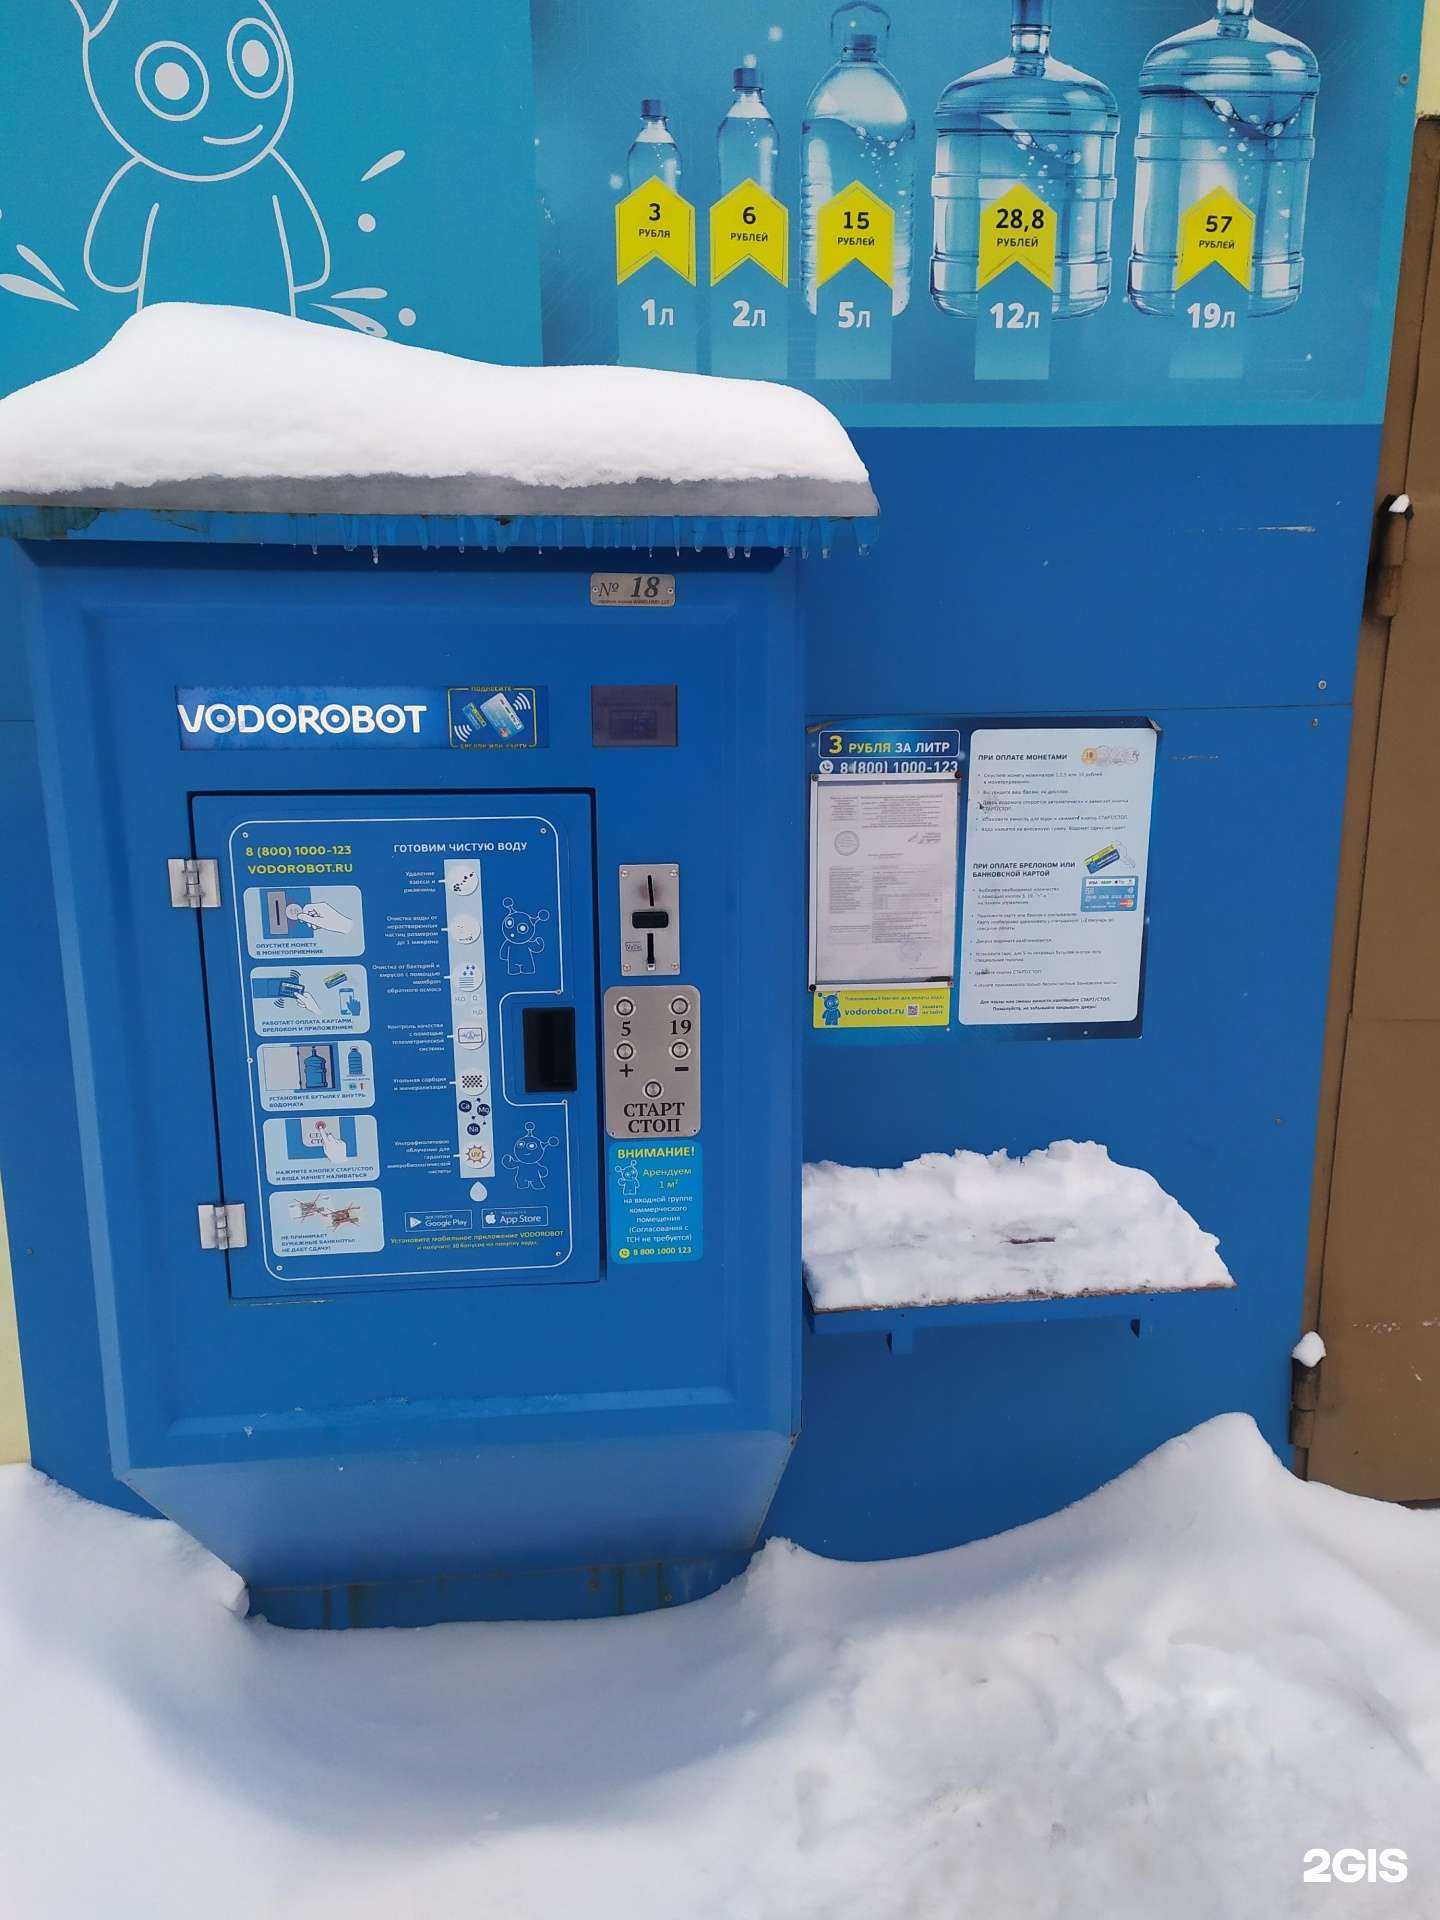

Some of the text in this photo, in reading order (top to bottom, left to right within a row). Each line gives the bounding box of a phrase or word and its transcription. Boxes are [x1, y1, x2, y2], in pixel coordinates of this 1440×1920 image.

[649, 203, 661, 221] 3
[743, 207, 756, 224] 6
[843, 212, 870, 230] 15
[996, 208, 1045, 232] 28,8
[1205, 215, 1232, 233] 57
[638, 229, 671, 238] РУБЛЯ
[730, 231, 768, 242] РУБЛЕЙ
[837, 236, 875, 246] РУБЛЕЙ
[996, 236, 1039, 248] РУБЛЕЙ
[1199, 239, 1236, 249] РУБЛЕЙ
[641, 299, 674, 326] 1л
[732, 300, 766, 327] 2л
[838, 302, 871, 329] 5л
[990, 302, 1040, 329] 12л
[1187, 302, 1236, 329] 19л
[630, 576, 661, 598] 18
[177, 703, 427, 735] VODOROBOT
[828, 735, 951, 754] 3 РУБЛЯ ЗА ЛИТР
[1025, 753, 1068, 761] МОНЕТАМИ
[840, 760, 959, 774] 8 (800) 1000-123
[245, 845, 352, 858] 8 (800) 1000-123
[394, 842, 528, 853] ГОТОВИМ ЧИСТУЮ ВОДУ
[248, 863, 353, 874] VODOROBOT.RU
[972, 870, 1050, 878] БАНКОВСКОЙ КАРТОЙ
[845, 1006, 905, 1016] vodorobot.ru
[621, 1019, 692, 1037] 5 19
[623, 1102, 685, 1118] СТАРТ
[628, 1118, 681, 1134] СТОП
[617, 1146, 695, 1159] ВНИМАНИЕ!
[643, 1168, 692, 1178] Арендуем
[659, 1181, 665, 1189] 1
[634, 1196, 666, 1204] входной
[667, 1196, 693, 1204] группе
[629, 1206, 688, 1215] коммерческого
[425, 1218, 467, 1229] Google Play
[500, 1215, 542, 1225] App Store
[636, 1215, 681, 1223] помещения
[519, 1230, 564, 1238] VODOROBOT
[653, 1233, 692, 1243] требуется)
[640, 1248, 655, 1256] 800
[657, 1247, 676, 1255] 1000
[678, 1246, 692, 1254] 123
